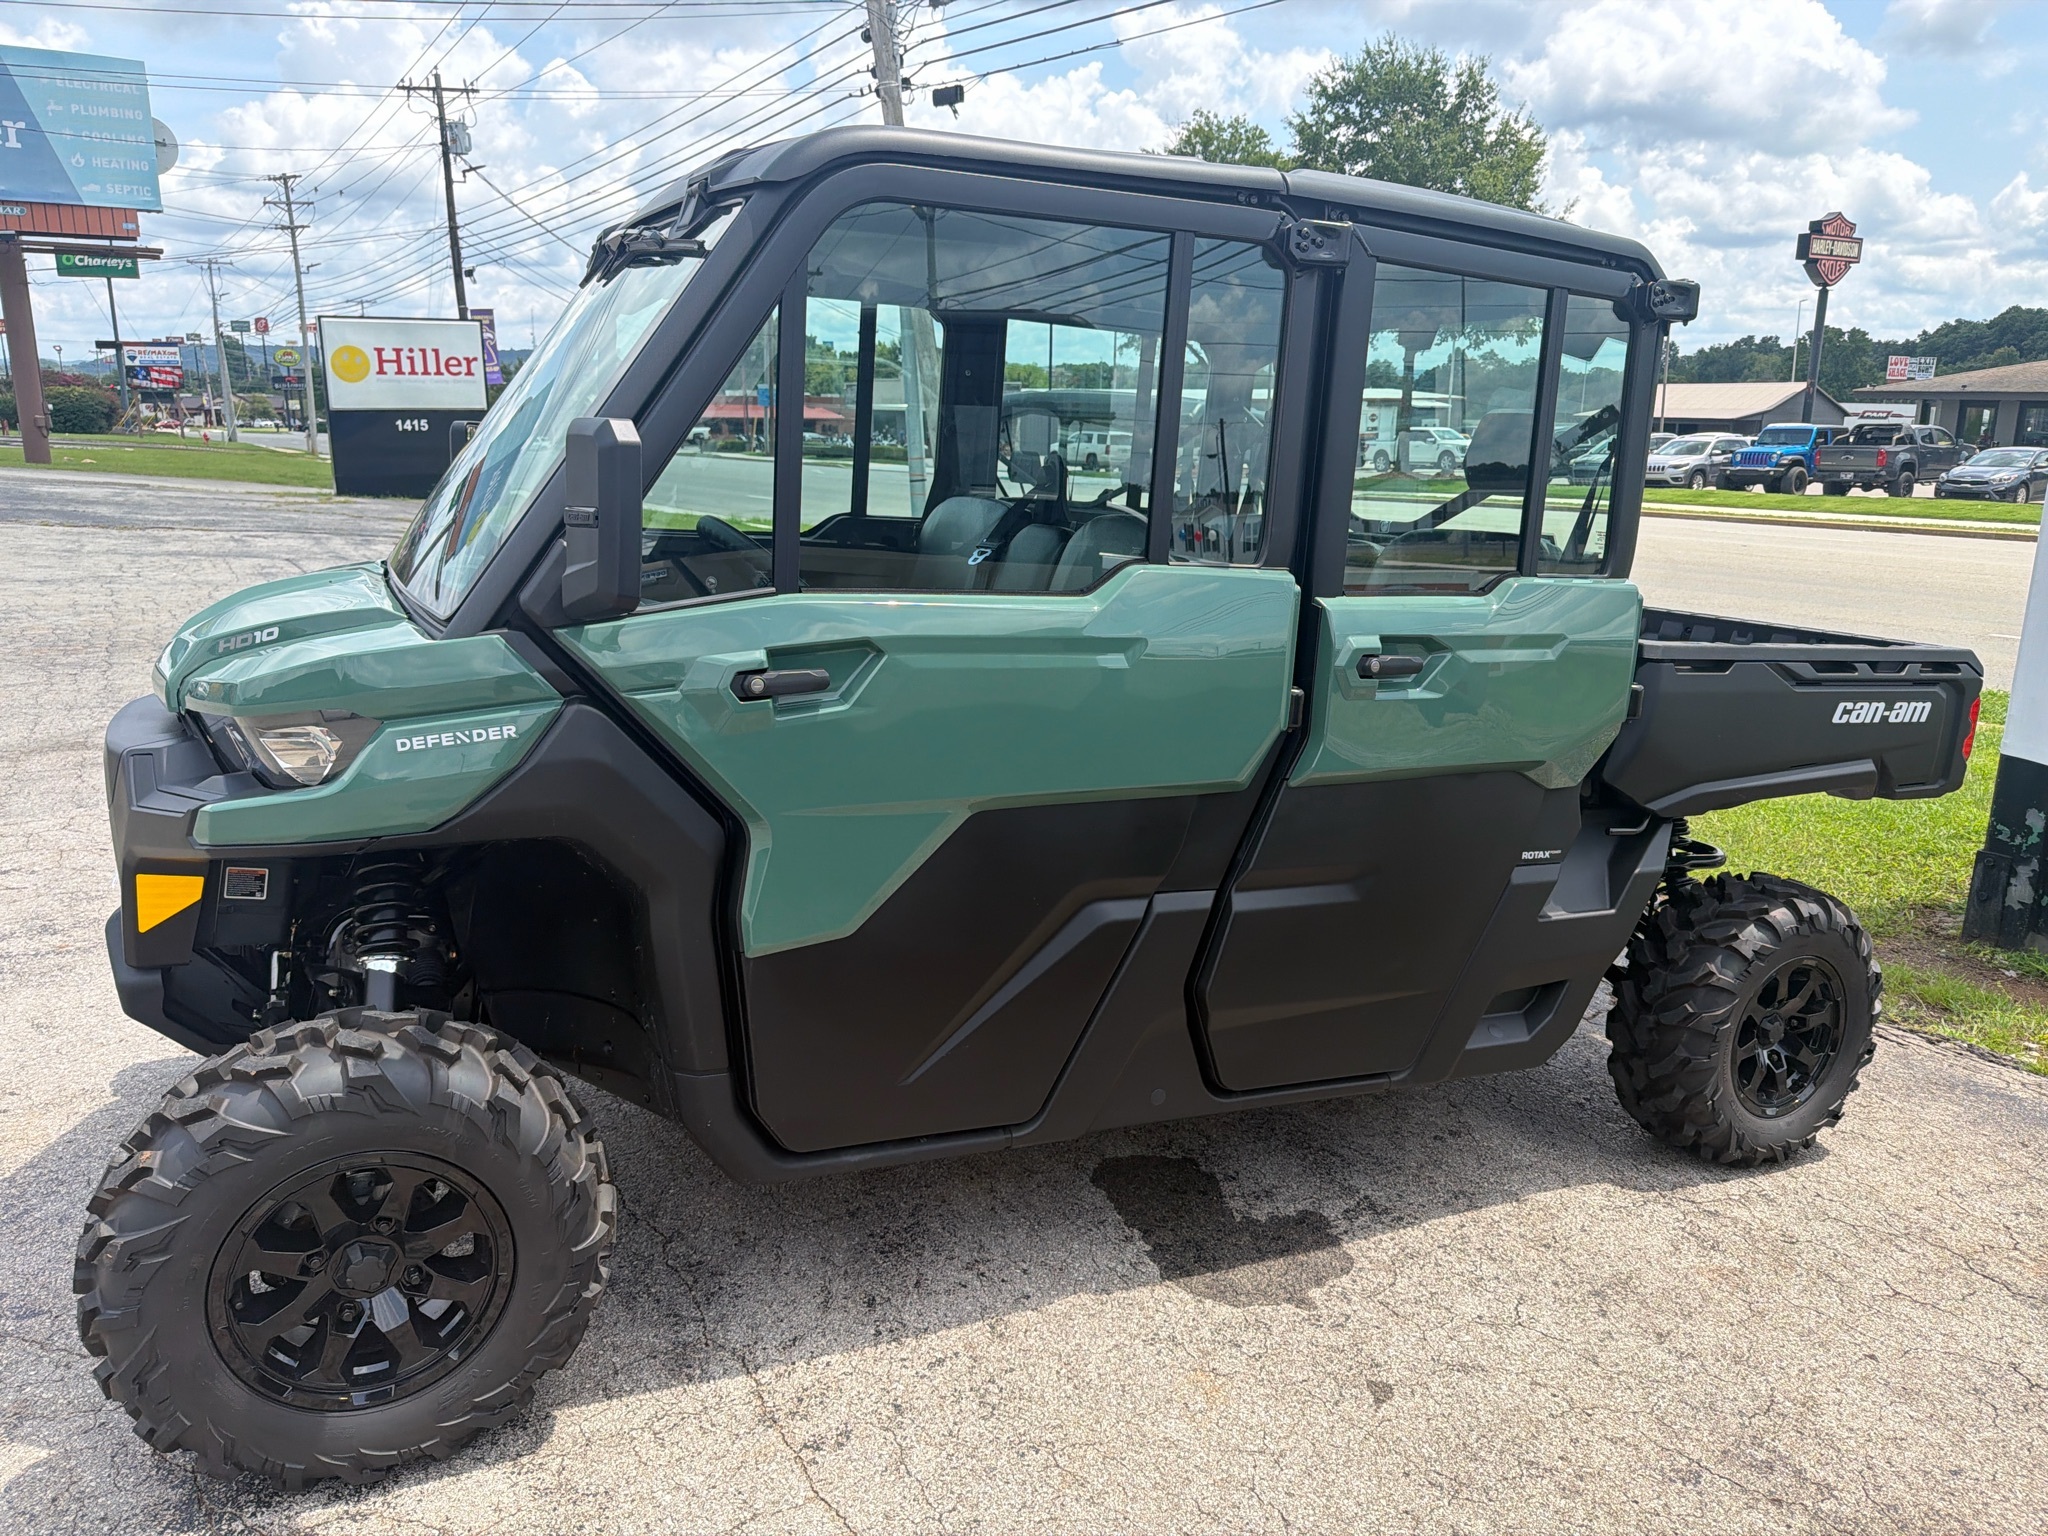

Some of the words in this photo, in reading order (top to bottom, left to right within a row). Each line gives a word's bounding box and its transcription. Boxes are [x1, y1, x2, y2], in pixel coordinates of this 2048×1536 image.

[56, 77, 140, 95] ELECTRICAL
[71, 103, 143, 120] PLUMBING
[0, 120, 26, 148] r
[81, 130, 146, 145] COOLING
[92, 156, 149, 171] HEATING
[106, 183, 151, 196] SEPTIC
[1826, 219, 1851, 237] MOTOR
[1811, 238, 1859, 258] HARLEY-DAVIDSON
[1821, 259, 1846, 280] CYCLES
[373, 347, 478, 377] Hiller
[1889, 356, 1909, 367] LOVE
[1918, 357, 1936, 366] EXIT
[1888, 368, 1908, 377] SHACK
[395, 419, 429, 432] 1415
[218, 627, 279, 653] HD10
[1831, 701, 1932, 724] can-am
[396, 725, 517, 752] DEFENDER
[1521, 851, 1550, 860] ROTAX
